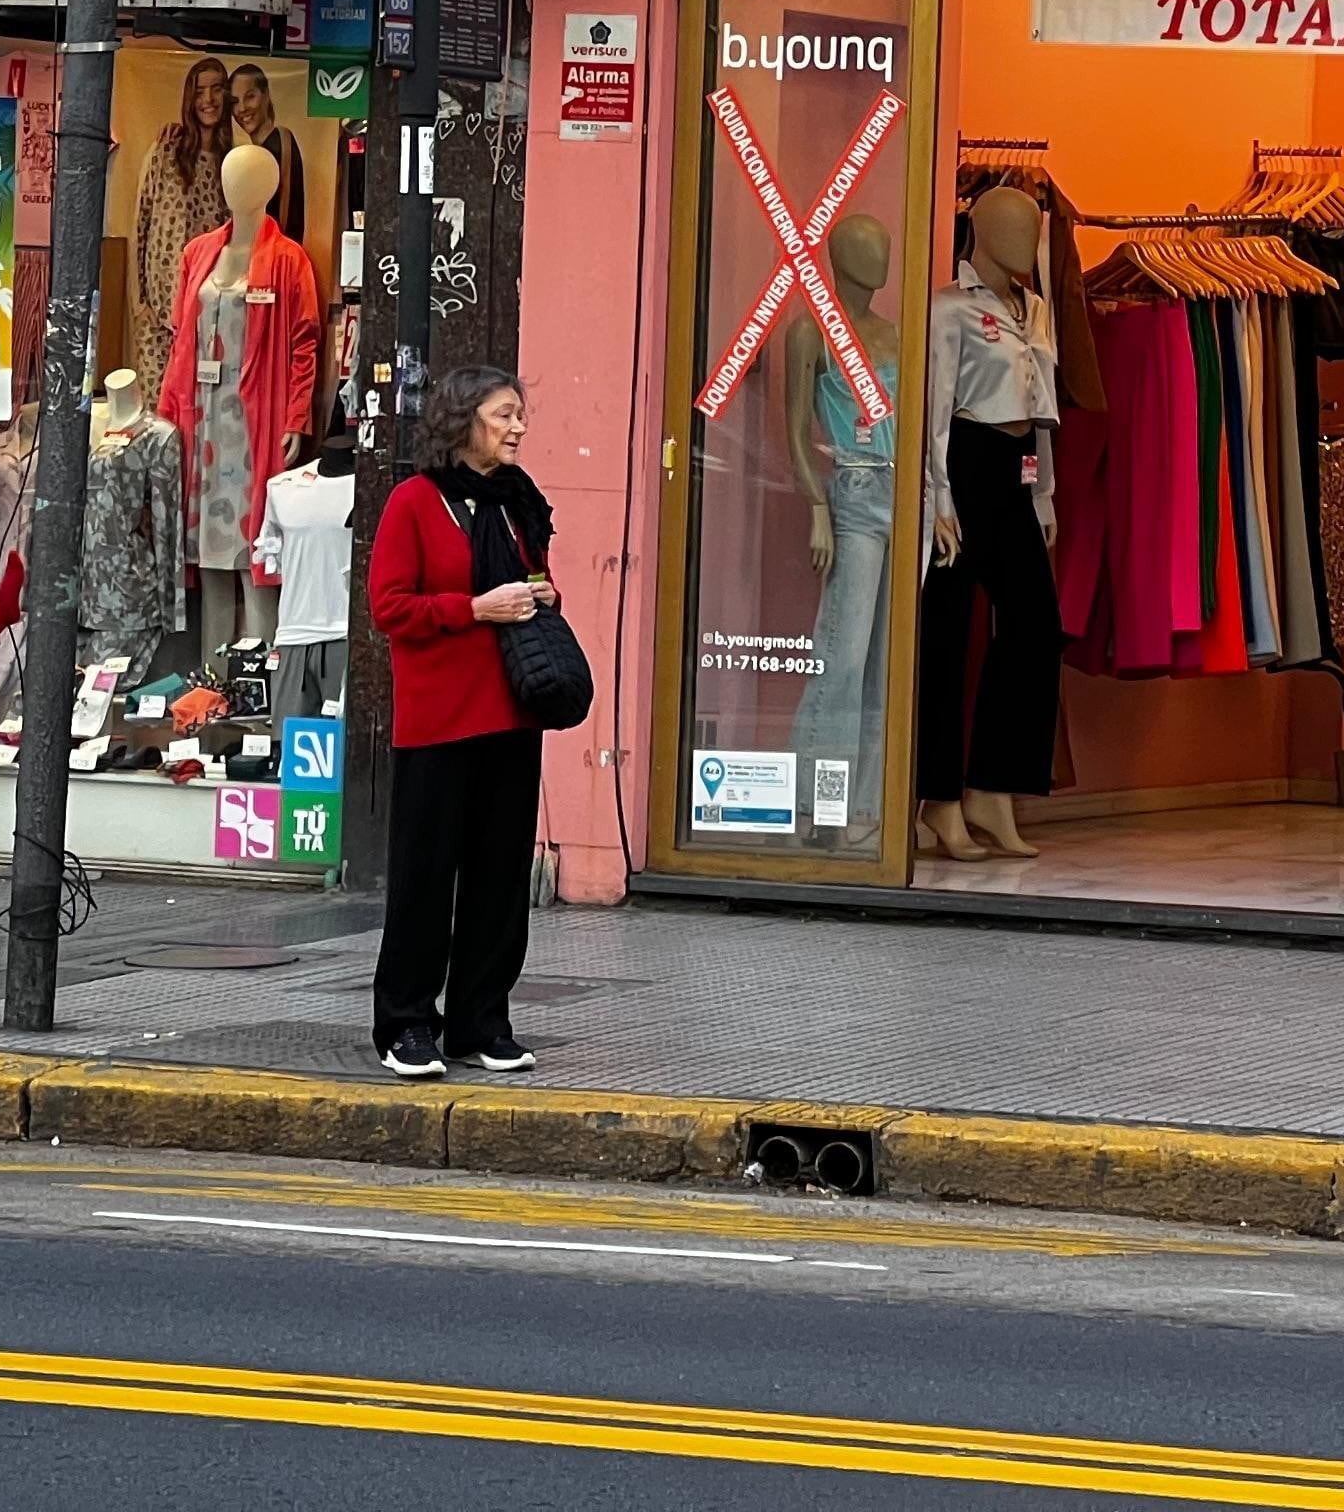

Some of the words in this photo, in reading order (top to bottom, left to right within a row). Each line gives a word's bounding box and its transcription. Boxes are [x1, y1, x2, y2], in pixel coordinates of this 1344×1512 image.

[387, 31, 410, 55] 152
[571, 46, 628, 57] verisure
[567, 65, 630, 85] Alarma
[699, 325, 764, 418] LIQUIDACION
[752, 264, 795, 326] INVIERN
[847, 96, 900, 169] INVIERNO
[711, 87, 770, 186] LIQUIDACION
[758, 181, 805, 255] INVIERNO
[793, 251, 853, 351] LIQUIDACION
[840, 344, 887, 418] INVIERNO
[714, 630, 814, 652] b.youngmoda
[715, 654, 825, 675] 11-7168-9023
